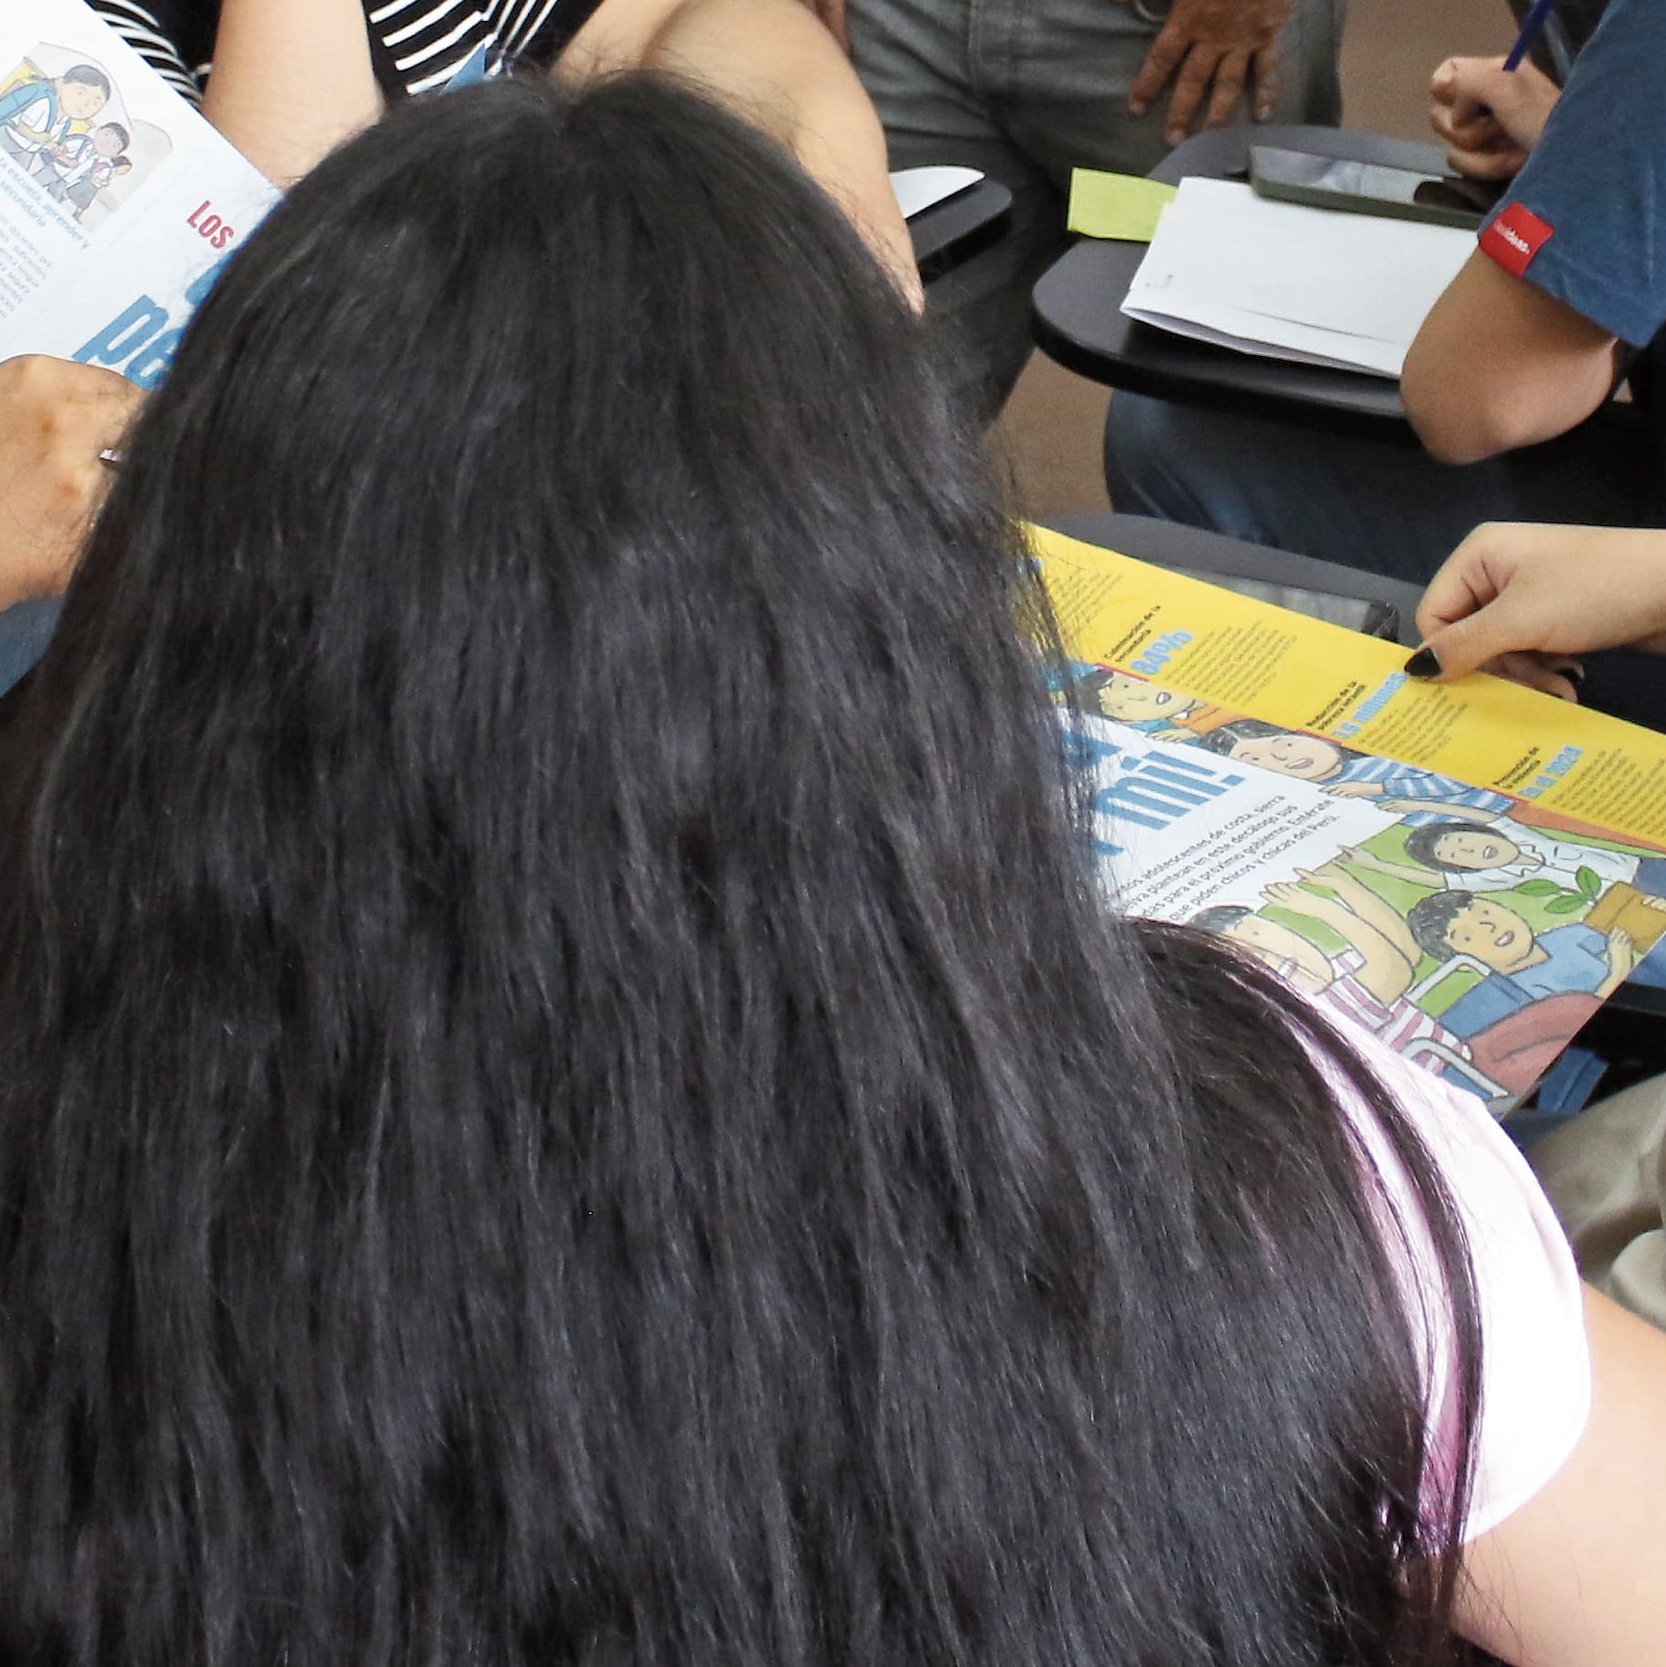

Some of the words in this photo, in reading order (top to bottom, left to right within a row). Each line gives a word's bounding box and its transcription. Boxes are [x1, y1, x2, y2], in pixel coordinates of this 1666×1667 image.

[5, 165, 46, 205] escuela,
[39, 200, 84, 245] aprender
[78, 240, 90, 252] y
[1130, 630, 1193, 675] 84%
